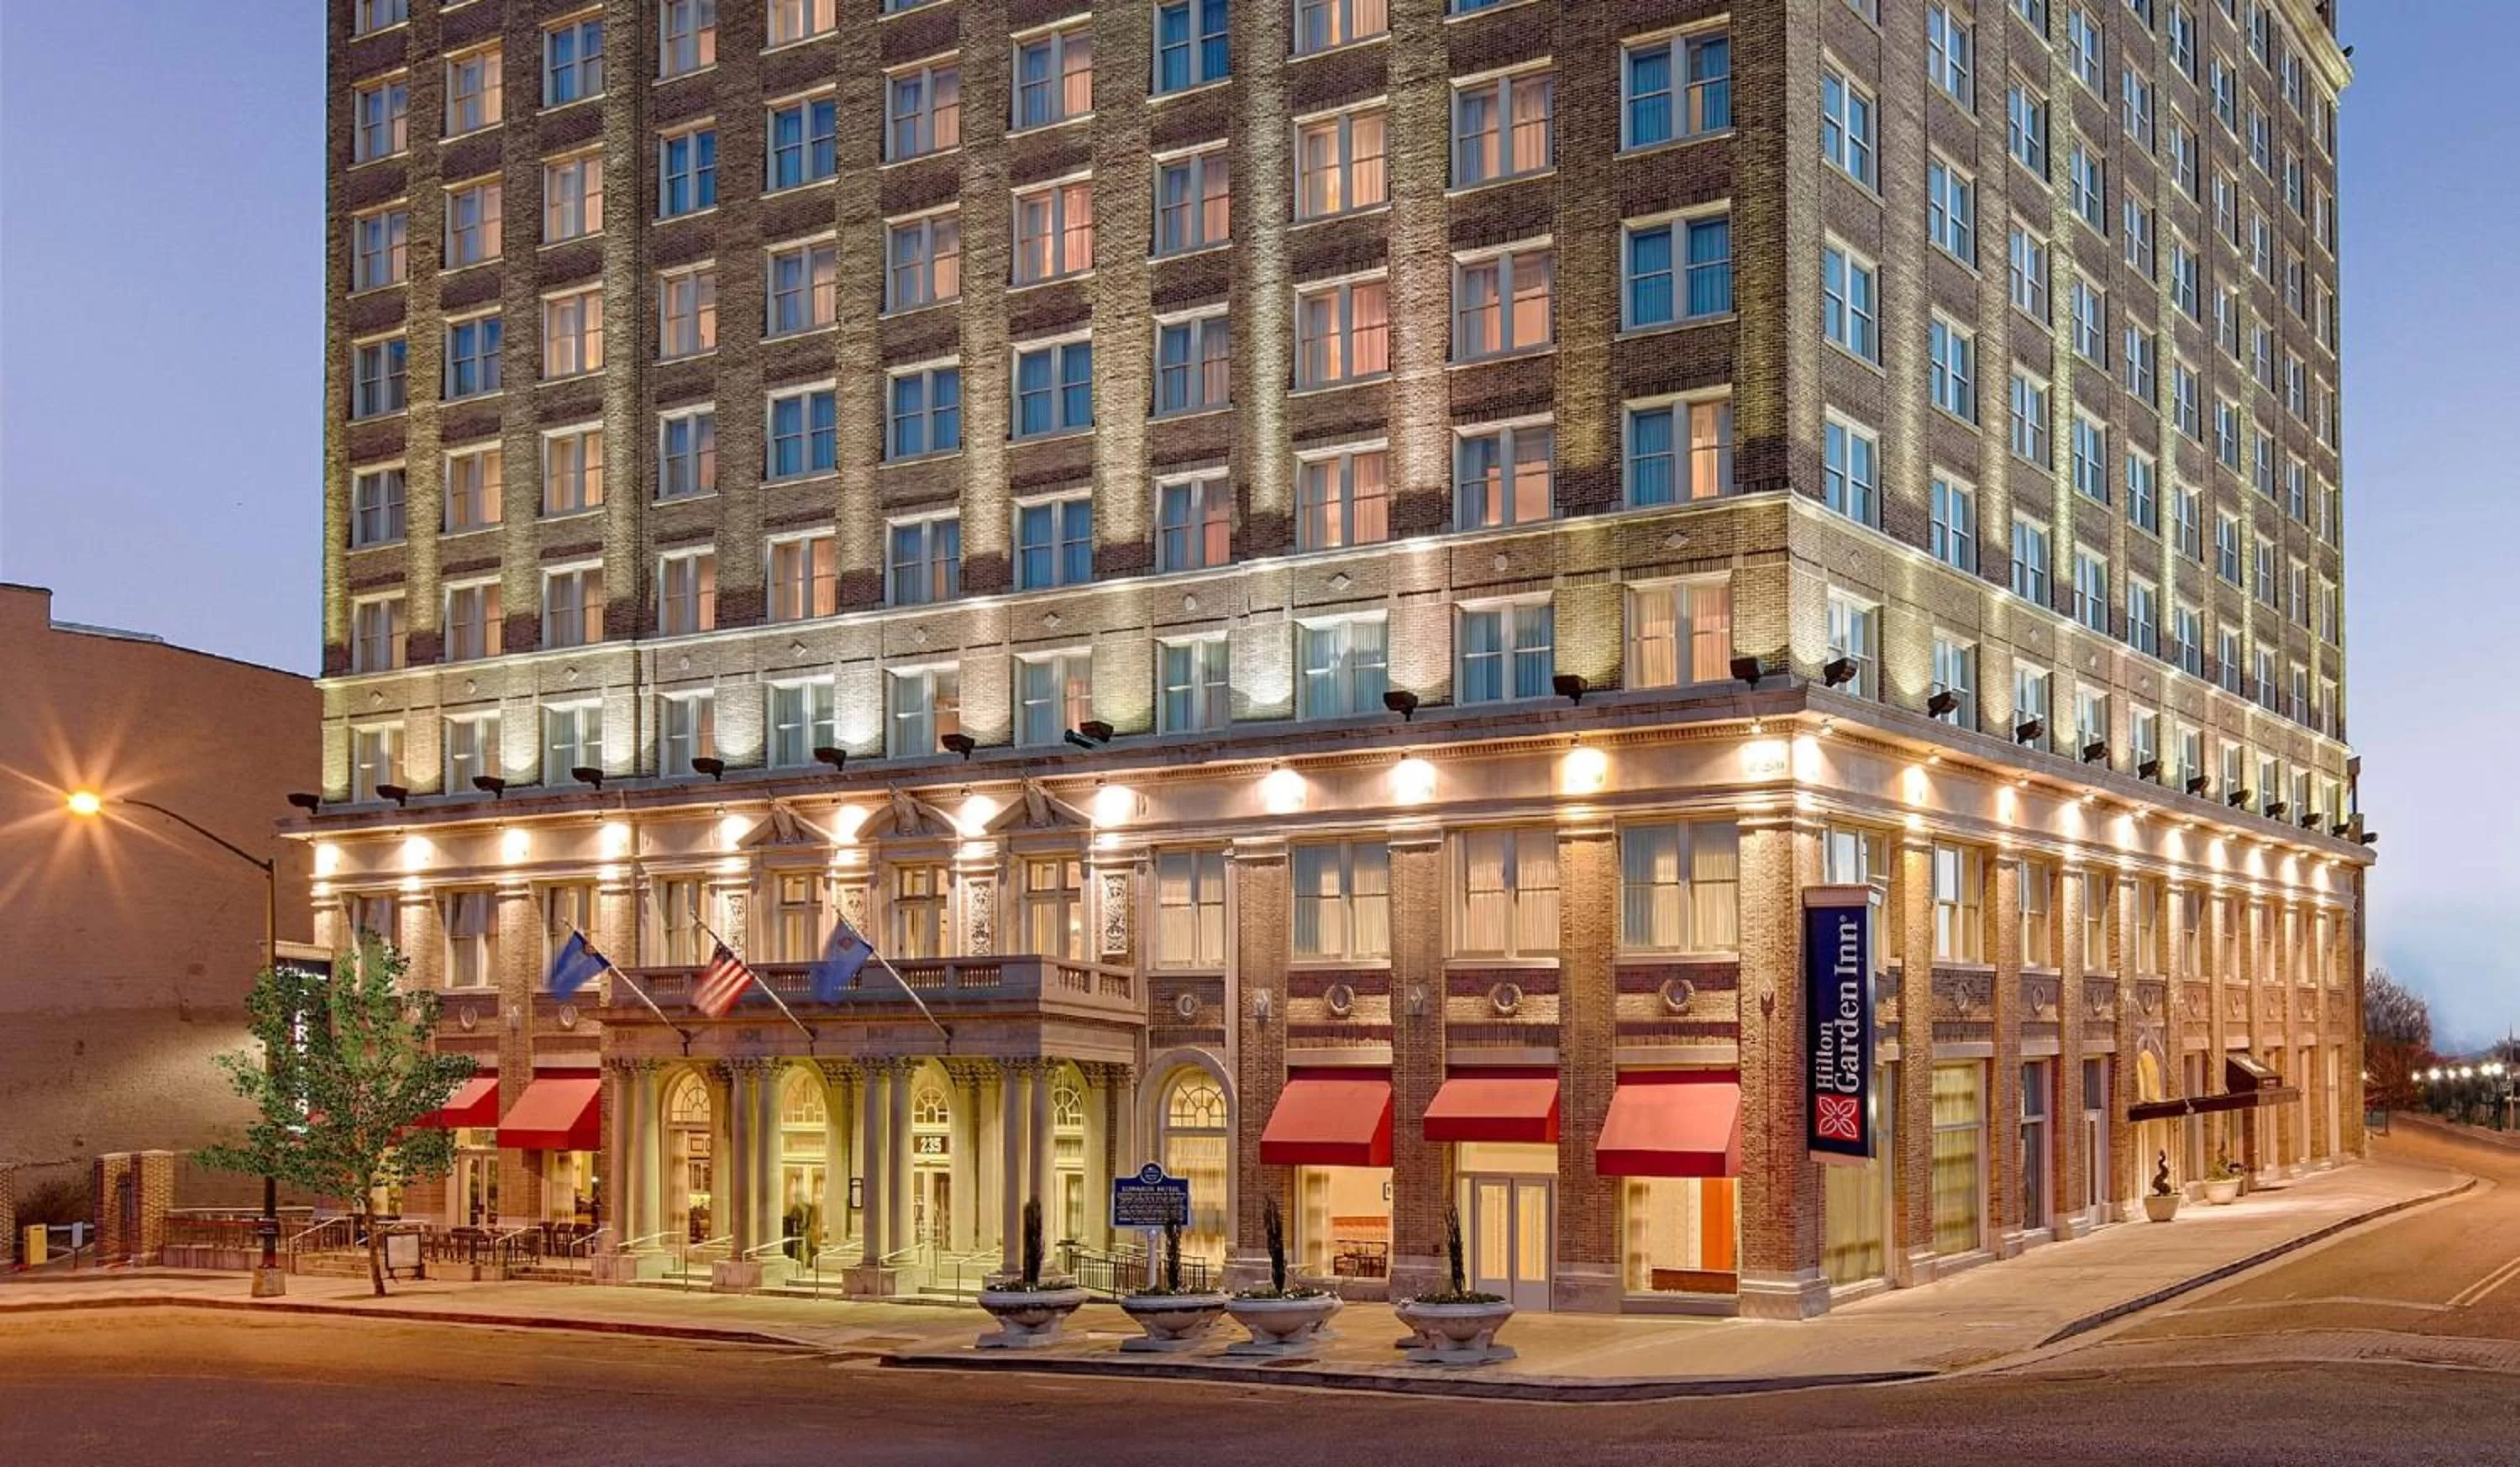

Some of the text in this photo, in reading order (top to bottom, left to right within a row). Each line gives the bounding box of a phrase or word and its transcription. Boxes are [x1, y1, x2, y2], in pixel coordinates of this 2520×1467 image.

[1815, 1021, 1834, 1090] Hilton
[1834, 977, 1860, 1093] Garden
[920, 1137, 942, 1153] 235
